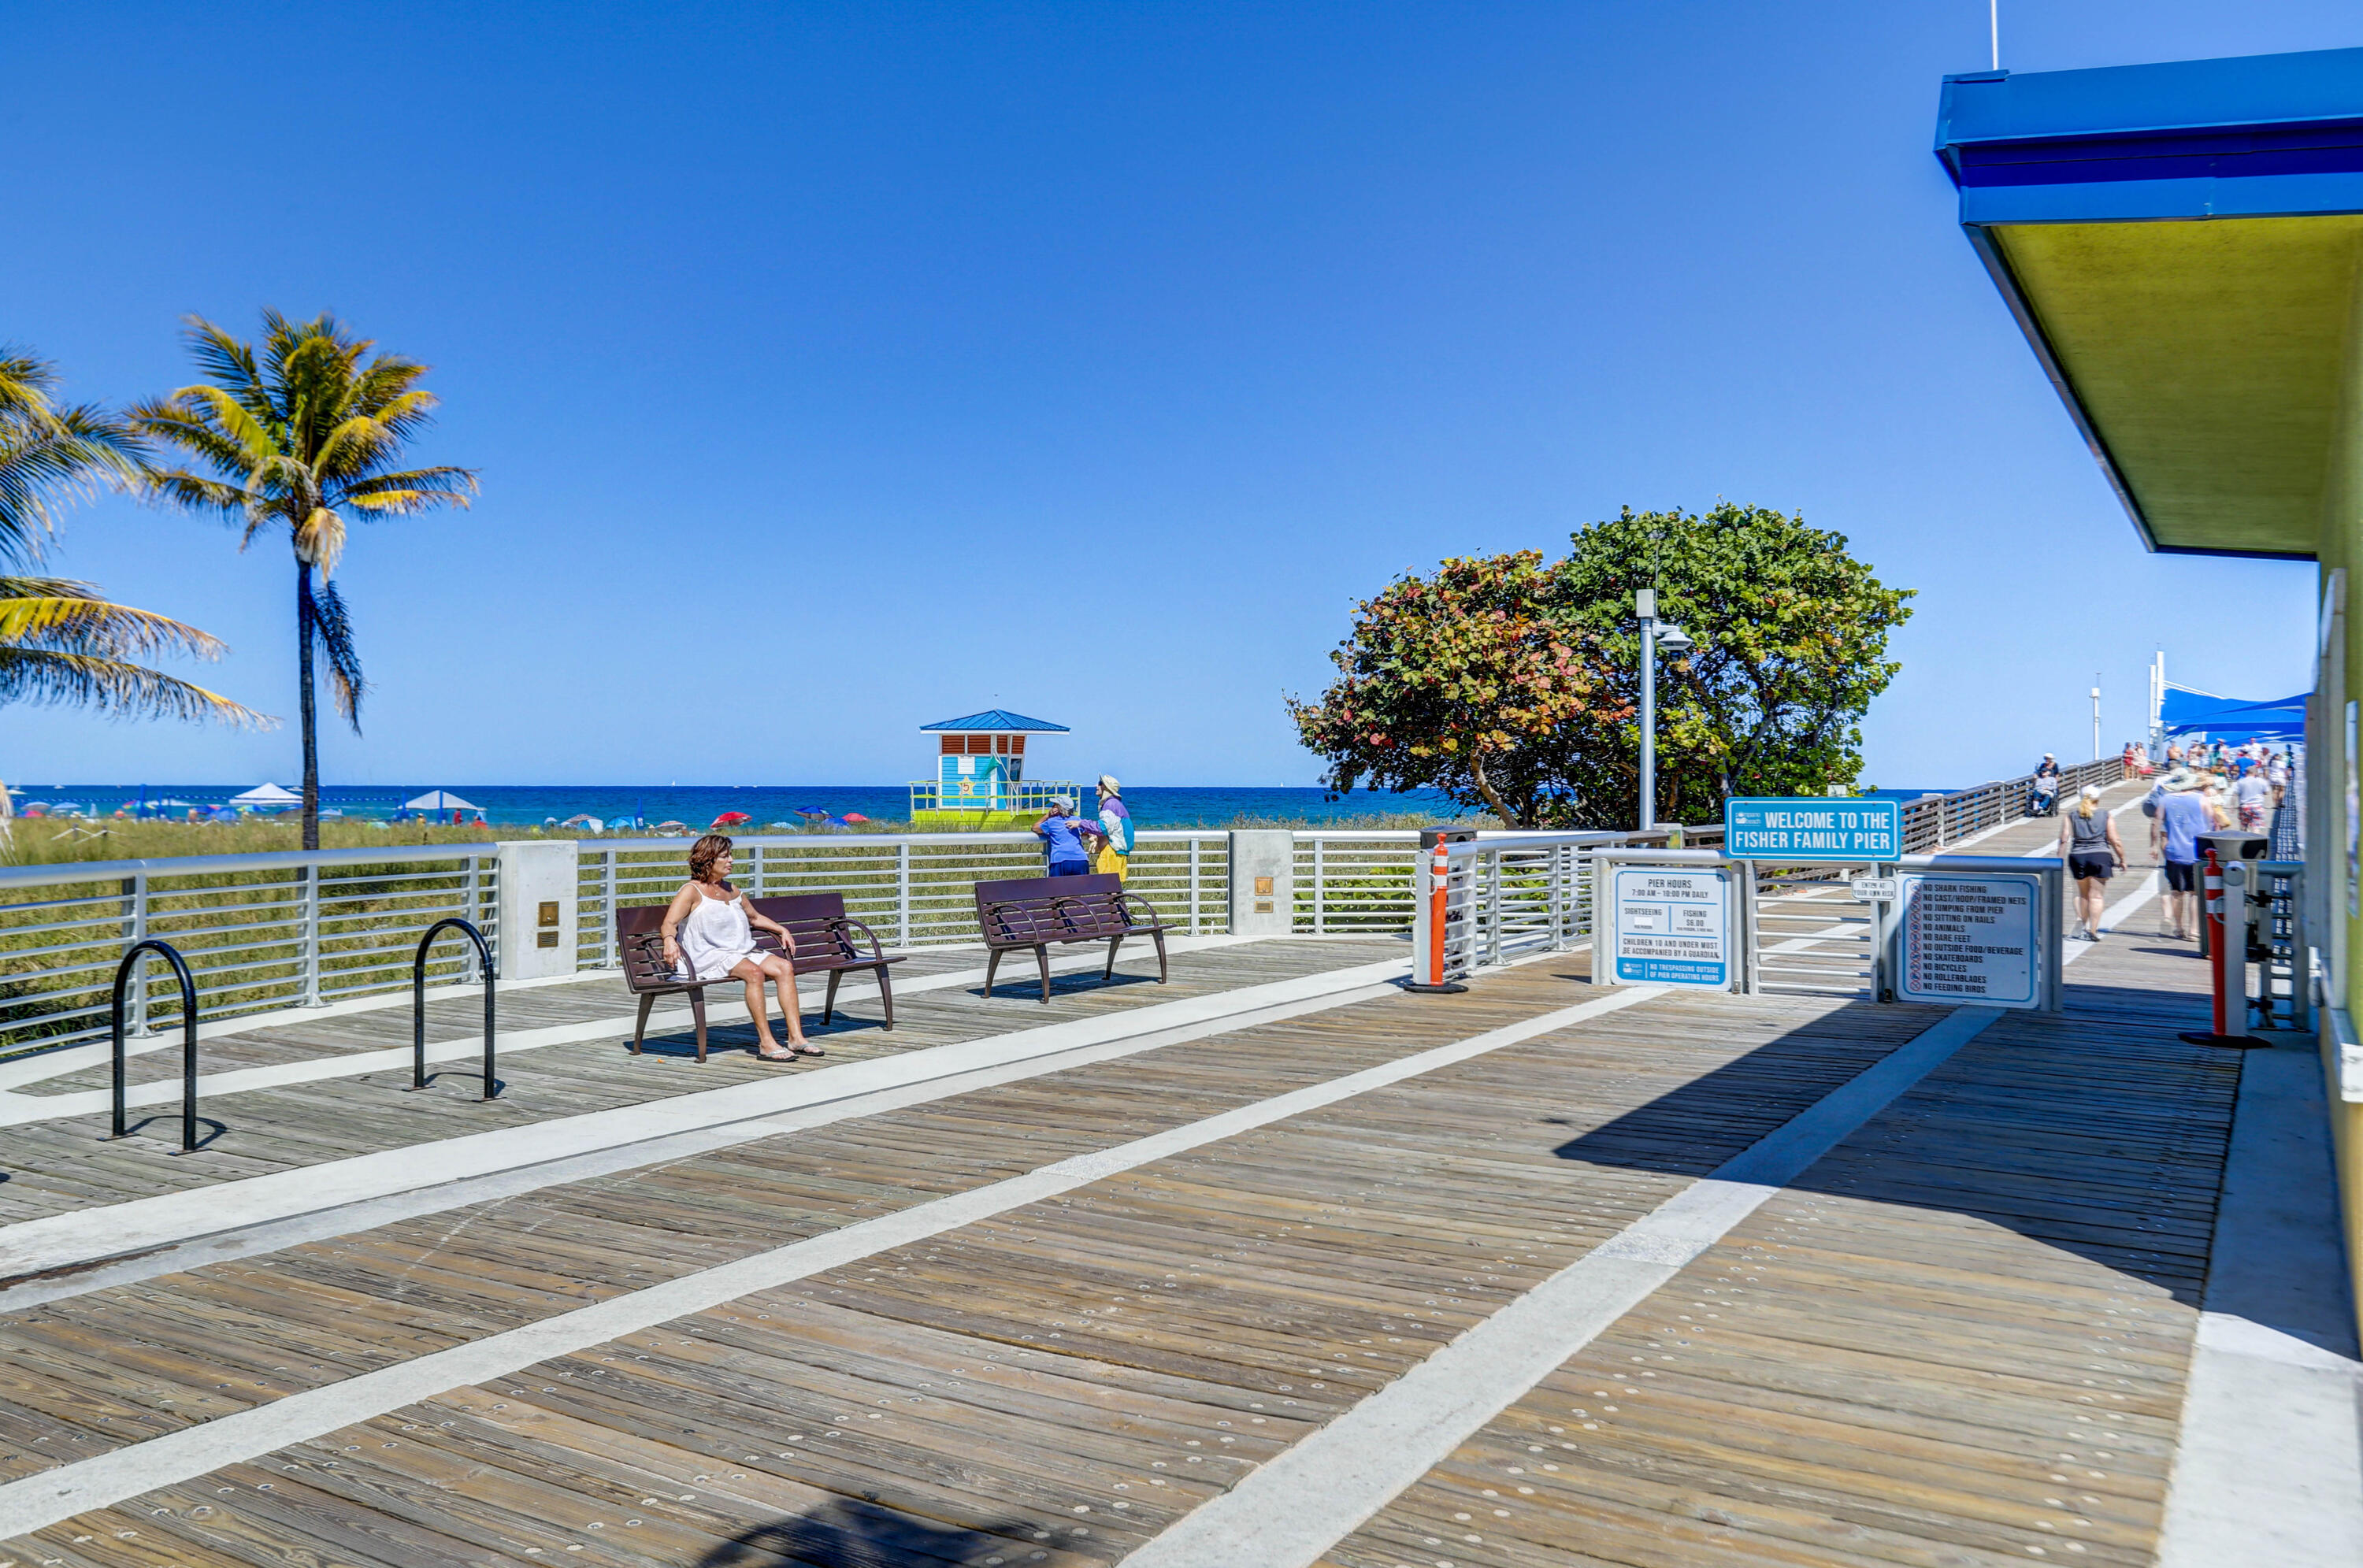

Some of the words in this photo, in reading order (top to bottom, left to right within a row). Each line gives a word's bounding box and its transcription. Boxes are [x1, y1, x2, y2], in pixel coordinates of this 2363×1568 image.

[963, 783, 969, 791] 5
[1764, 812, 1835, 828] WELCOME
[1838, 812, 1857, 828] TO
[1861, 812, 1890, 828] THE
[1735, 832, 1788, 847] FISHER
[1794, 832, 1848, 849] FAMILY
[1854, 832, 1890, 849] PIER
[1648, 879, 1665, 888] PIER
[1667, 880, 1692, 888] HOURS
[1935, 894, 2006, 904] CAST/HOOP/FRAMED
[1624, 907, 1662, 916] SIGHTSEEING
[1935, 914, 1961, 922] SITTING
[1935, 924, 1965, 932] ANIMALS
[1935, 933, 1952, 942] BARE
[1632, 947, 1672, 956] ACCOMPANIED
[1935, 943, 1963, 952] OUTSIDE
[1965, 945, 2024, 955] FOOD/BEVERAGE
[1935, 953, 1983, 963] SKATEBOARDS
[1935, 963, 1967, 972] BICYCLES
[1935, 973, 1986, 984] ROLLERBLADES
[1935, 983, 1963, 992] FEEDING
[1964, 985, 1986, 994] BIRDS
